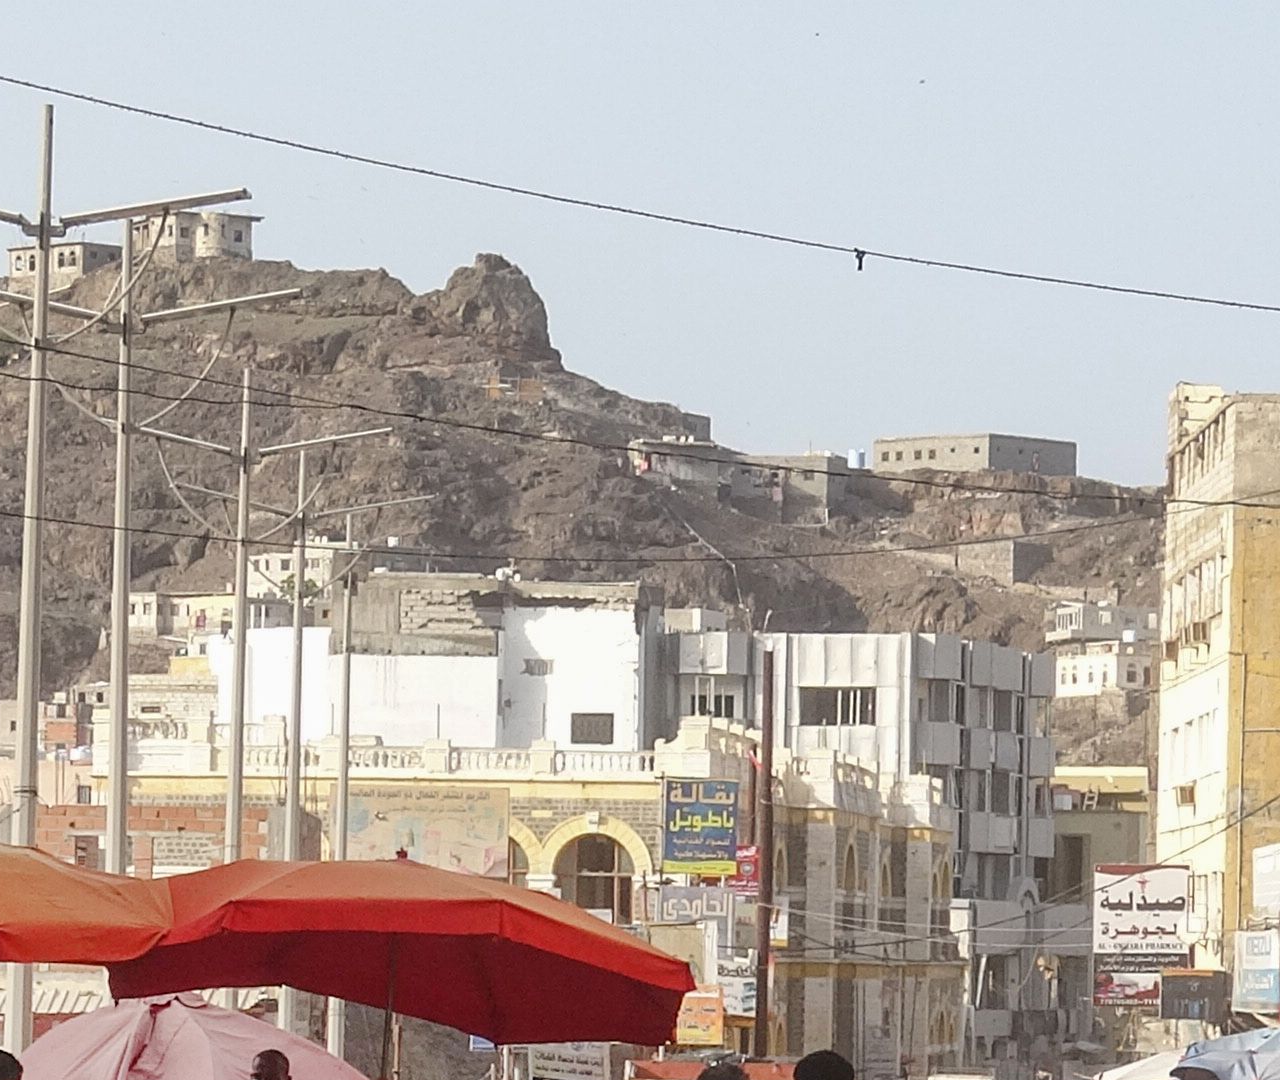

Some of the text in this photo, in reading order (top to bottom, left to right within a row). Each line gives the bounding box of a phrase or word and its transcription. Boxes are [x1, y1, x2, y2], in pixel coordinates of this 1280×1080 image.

[670, 783, 735, 811] بقالة
[670, 808, 734, 833] باطويل
[1100, 889, 1186, 917] صيدلية
[1101, 922, 1178, 940] لجوهرة
